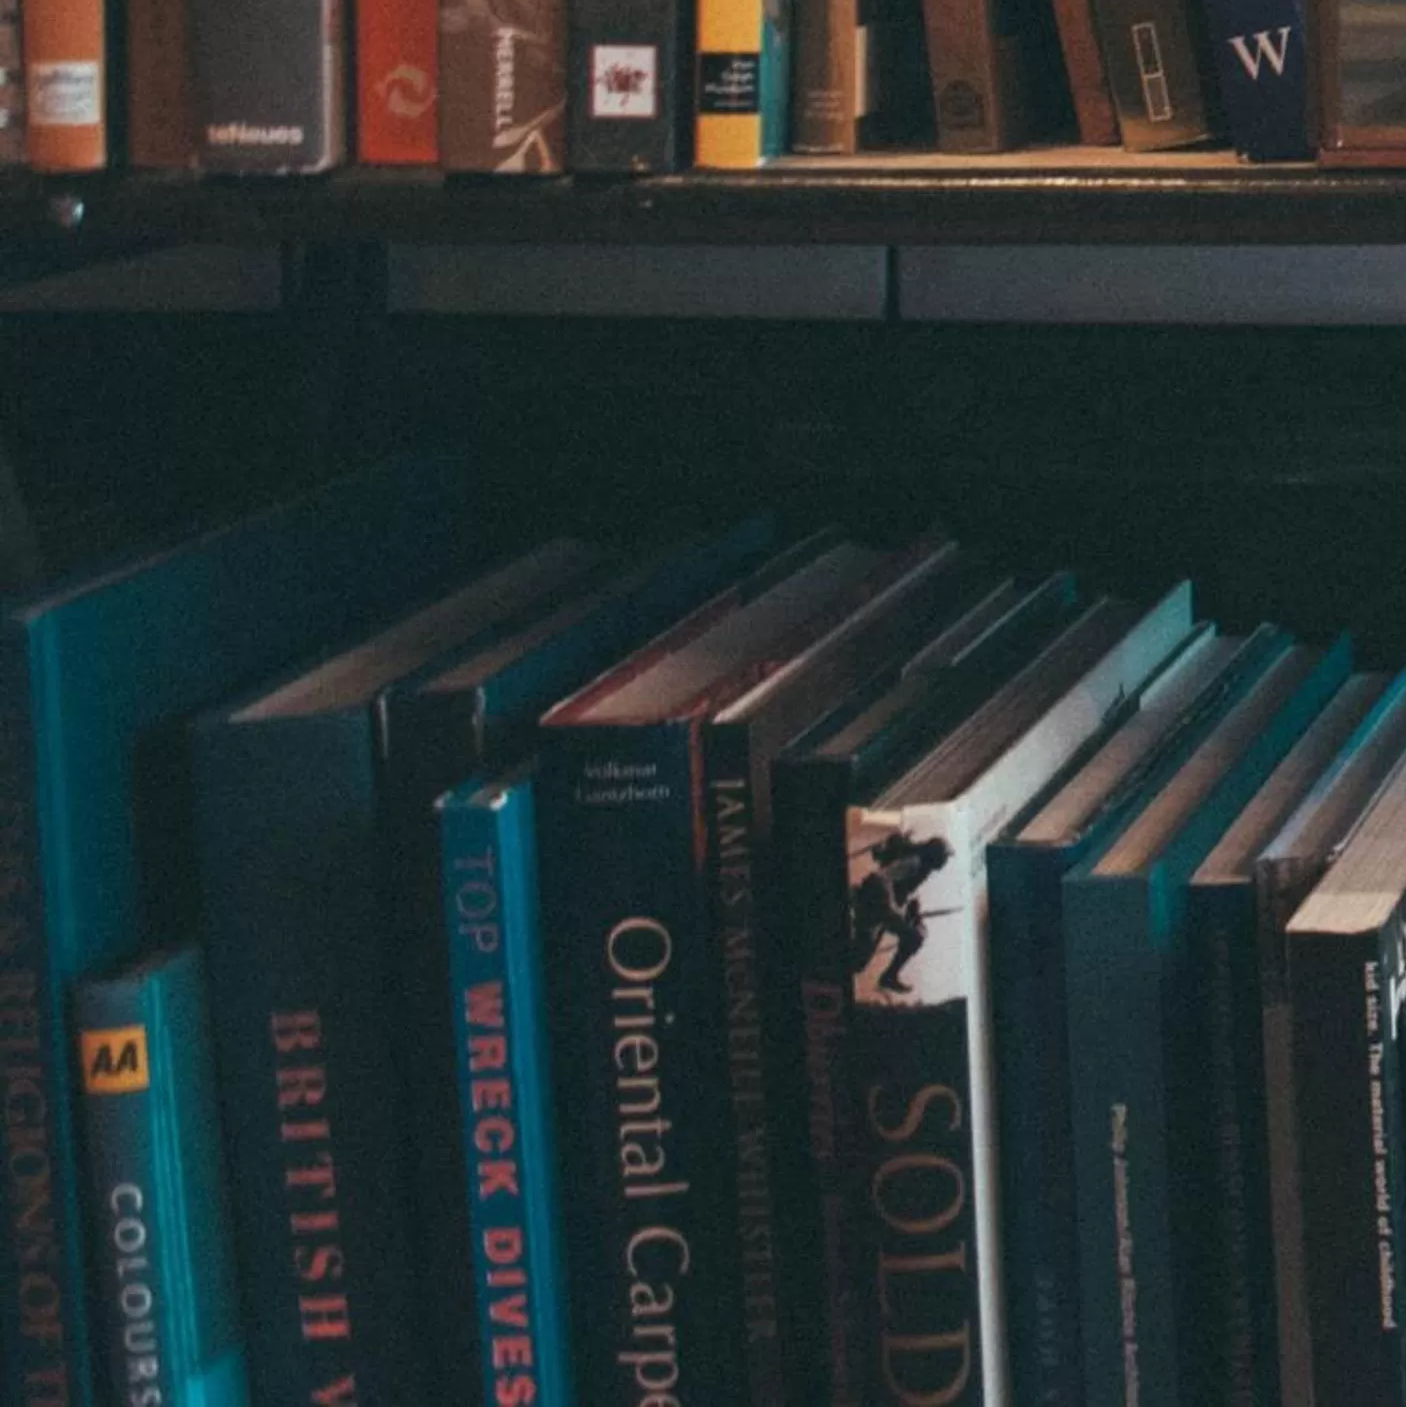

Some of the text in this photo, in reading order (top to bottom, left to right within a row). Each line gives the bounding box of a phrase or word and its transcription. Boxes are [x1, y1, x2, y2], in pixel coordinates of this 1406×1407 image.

[1227, 25, 1292, 81] W
[709, 777, 745, 907] JAMES
[1363, 960, 1382, 992] kid
[90, 1043, 140, 1080] AA
[606, 915, 690, 1199] Oriental
[1367, 1043, 1385, 1075] The
[453, 844, 540, 1407] TOP WRECK DIVES
[1370, 1080, 1389, 1155] material
[269, 1009, 351, 1341] BRITISH
[1372, 1159, 1391, 1212] world
[1376, 1215, 1393, 1235] of
[1377, 1240, 1399, 1331] childhood
